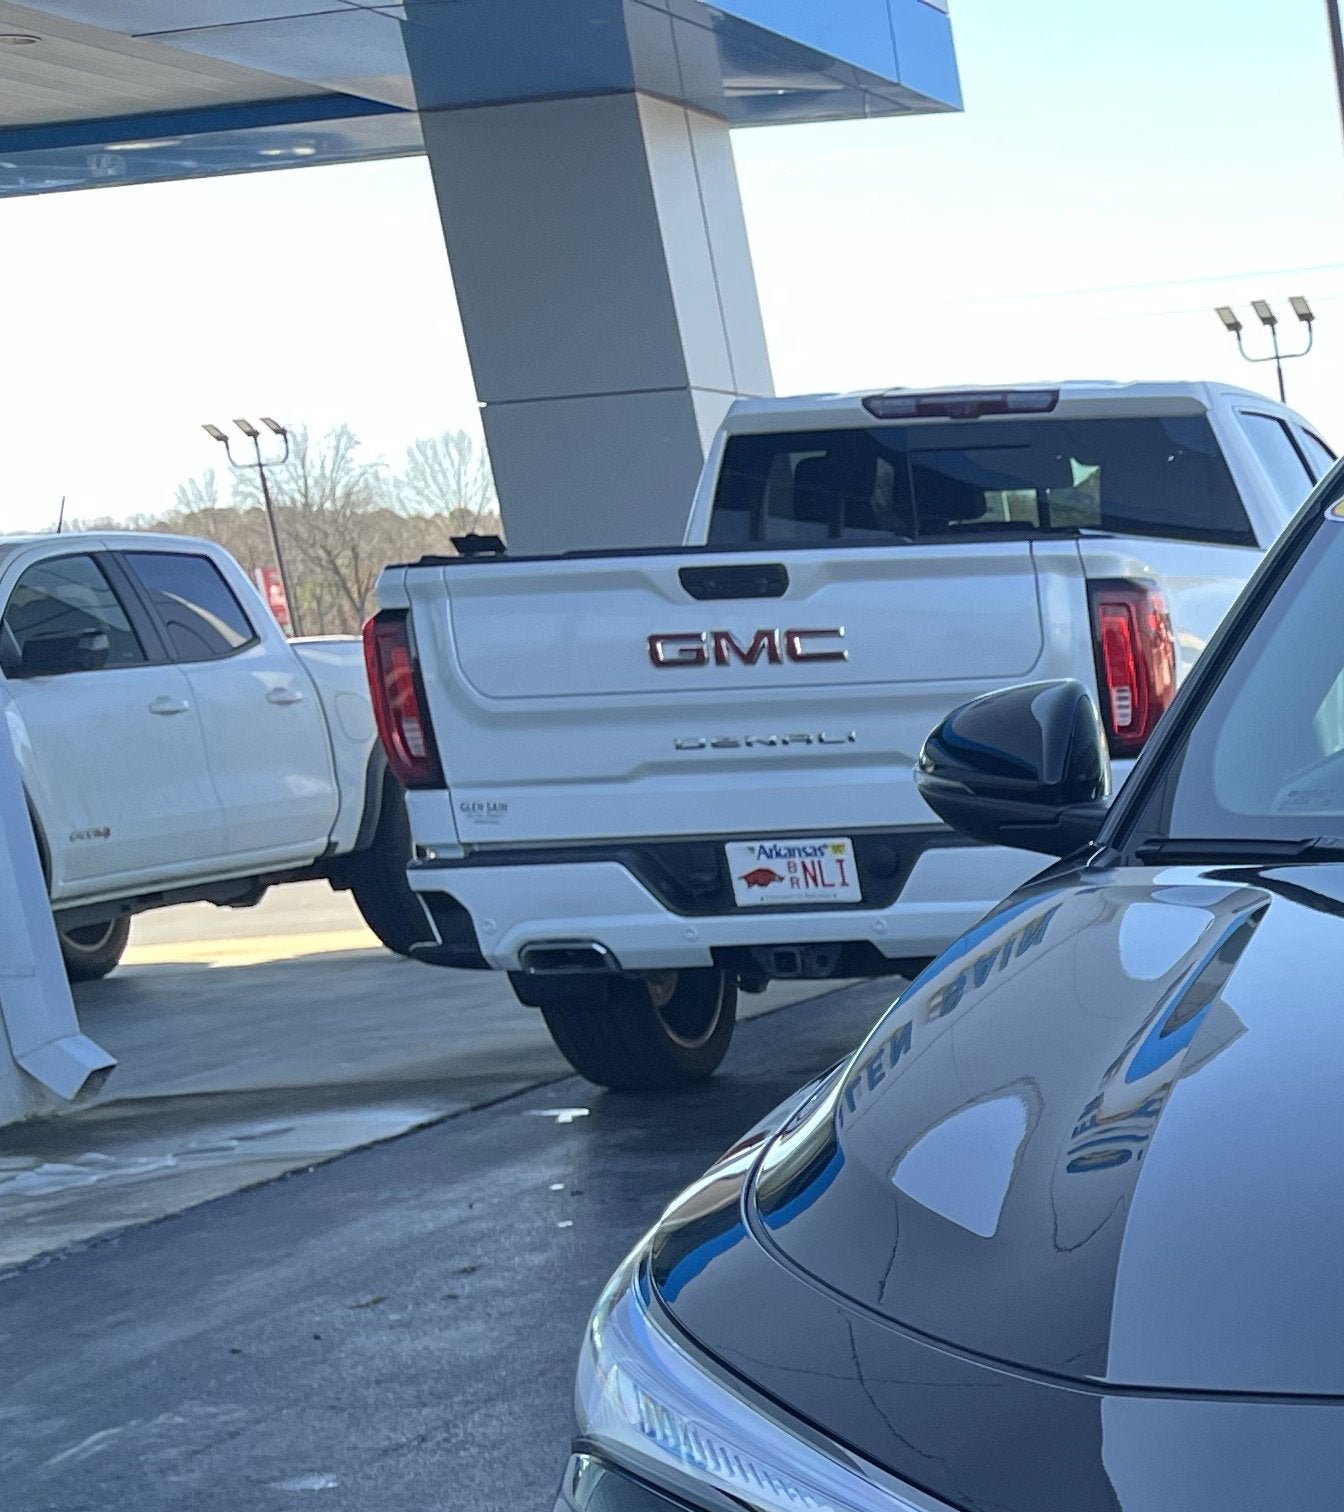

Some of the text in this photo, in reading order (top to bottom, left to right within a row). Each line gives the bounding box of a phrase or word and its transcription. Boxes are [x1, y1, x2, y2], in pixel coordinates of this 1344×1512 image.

[646, 625, 849, 667] GMC
[674, 729, 857, 750] DENALI
[757, 843, 826, 860] Arkansas
[801, 859, 849, 888] NLI
